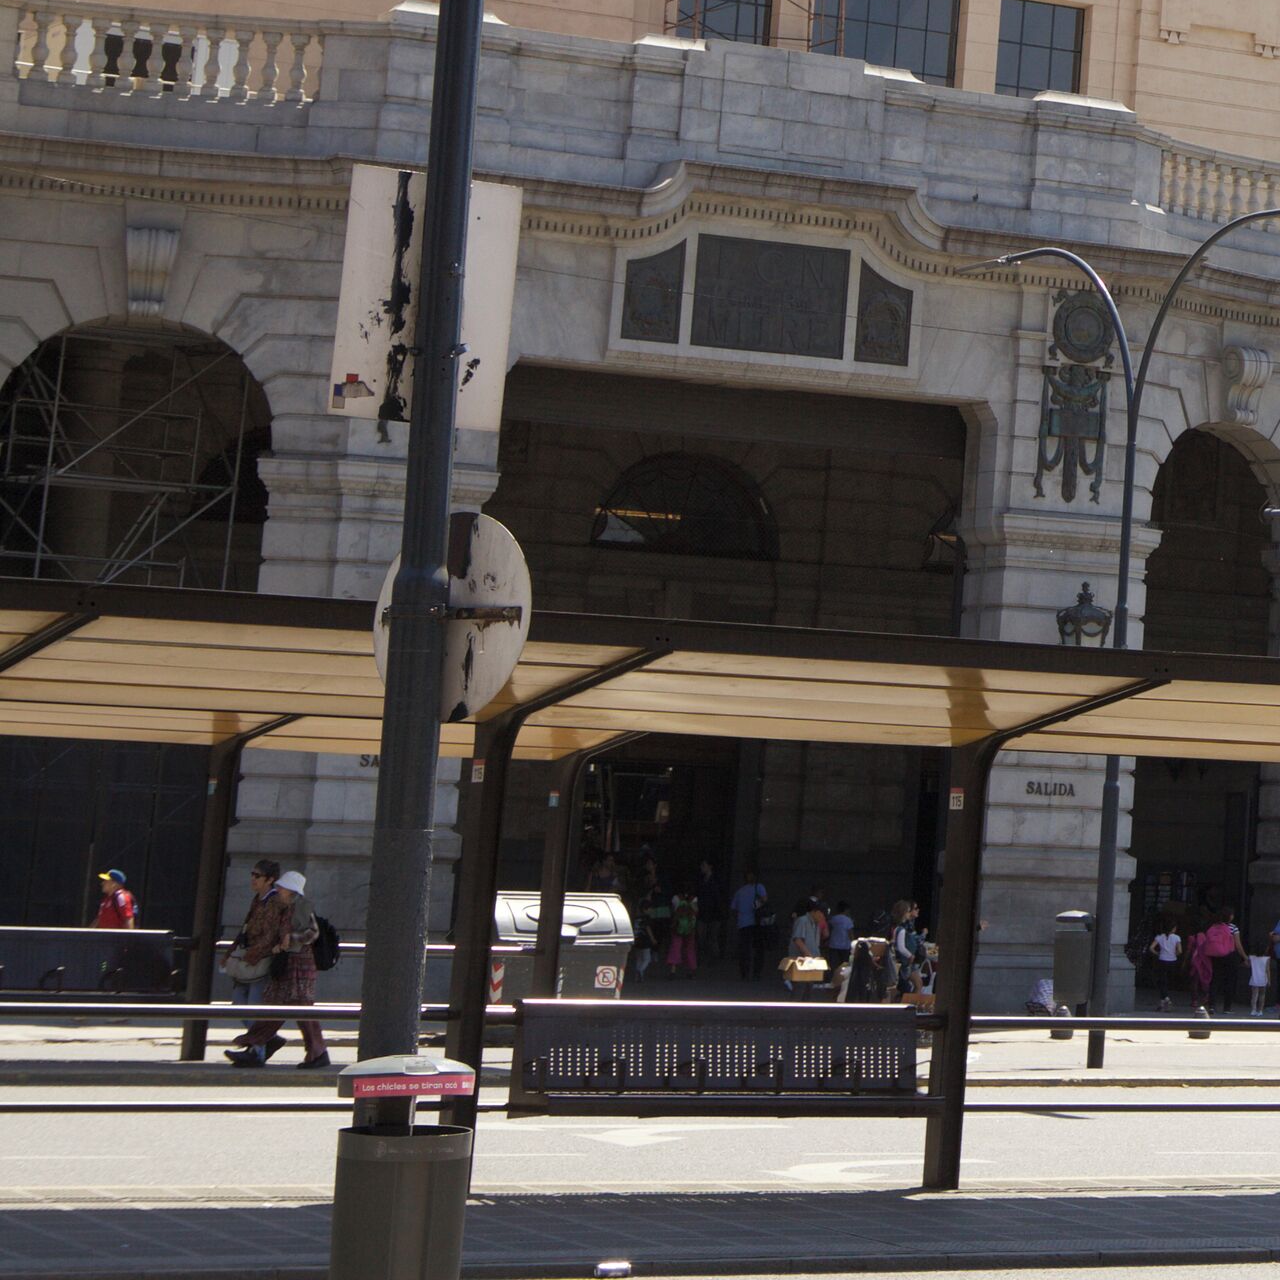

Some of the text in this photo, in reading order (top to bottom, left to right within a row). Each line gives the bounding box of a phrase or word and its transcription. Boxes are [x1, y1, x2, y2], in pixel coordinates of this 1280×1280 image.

[1025, 781, 1075, 797] SALIDA
[952, 795, 962, 807] 115
[362, 1083, 375, 1092] Los
[376, 1082, 407, 1091] chicles
